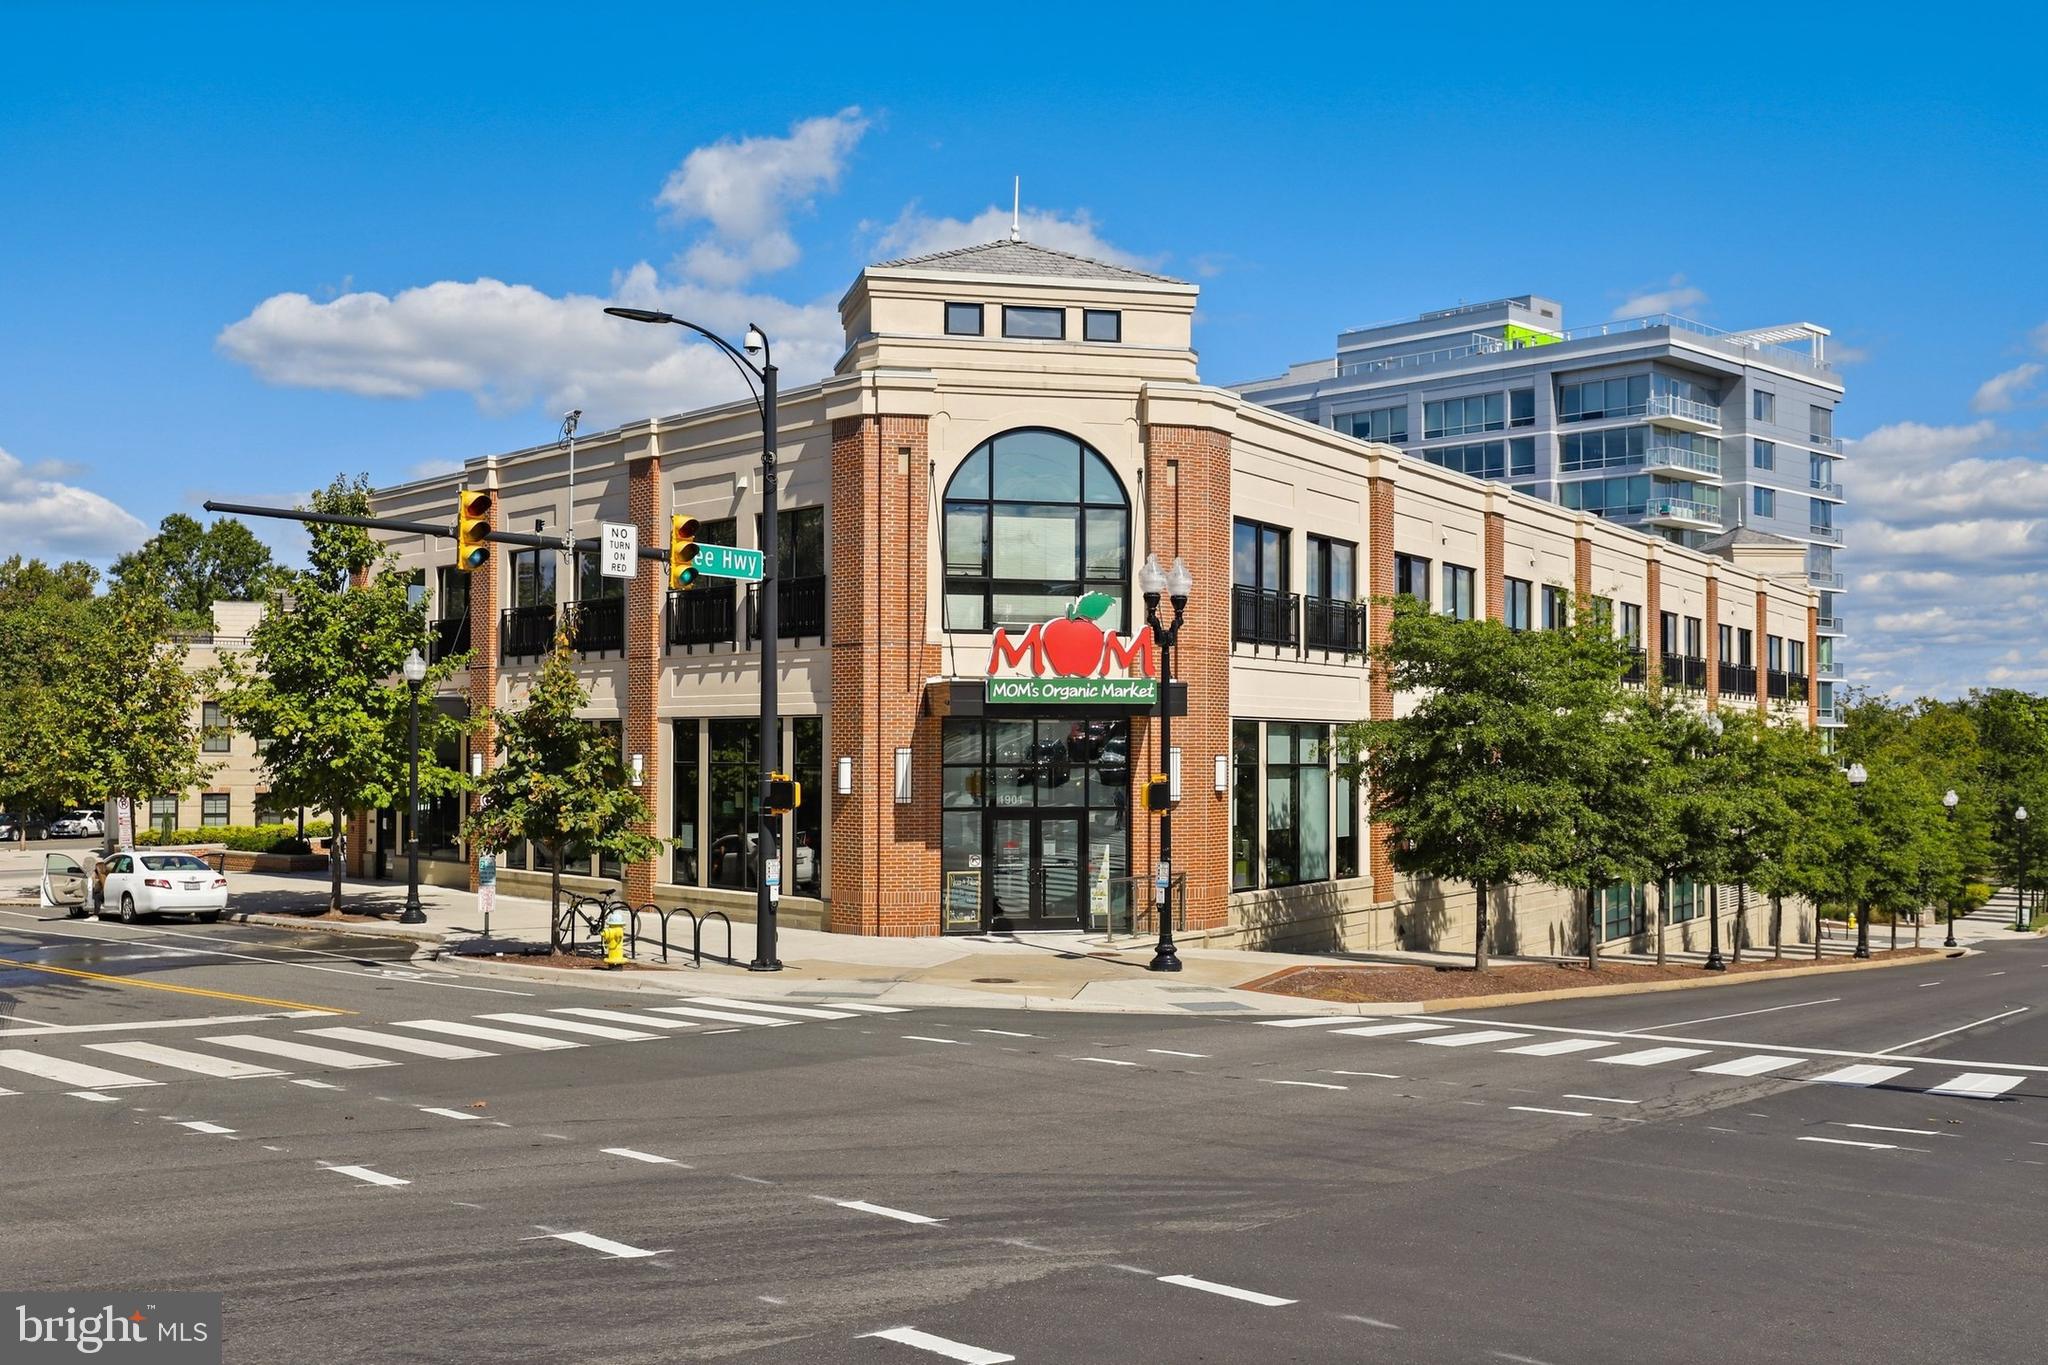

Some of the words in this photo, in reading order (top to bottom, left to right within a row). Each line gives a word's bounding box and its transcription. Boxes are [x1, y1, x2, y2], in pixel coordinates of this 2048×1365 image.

[611, 528, 628, 539] NO
[609, 540, 631, 550] TURN
[613, 552, 626, 561] ON
[611, 563, 627, 573] RED
[694, 550, 714, 568] ee
[722, 550, 757, 576] Hwy
[986, 617, 1156, 678] MOM
[992, 682, 1039, 698] MOM's
[1042, 682, 1099, 700] Organic
[1100, 682, 1155, 698] Market
